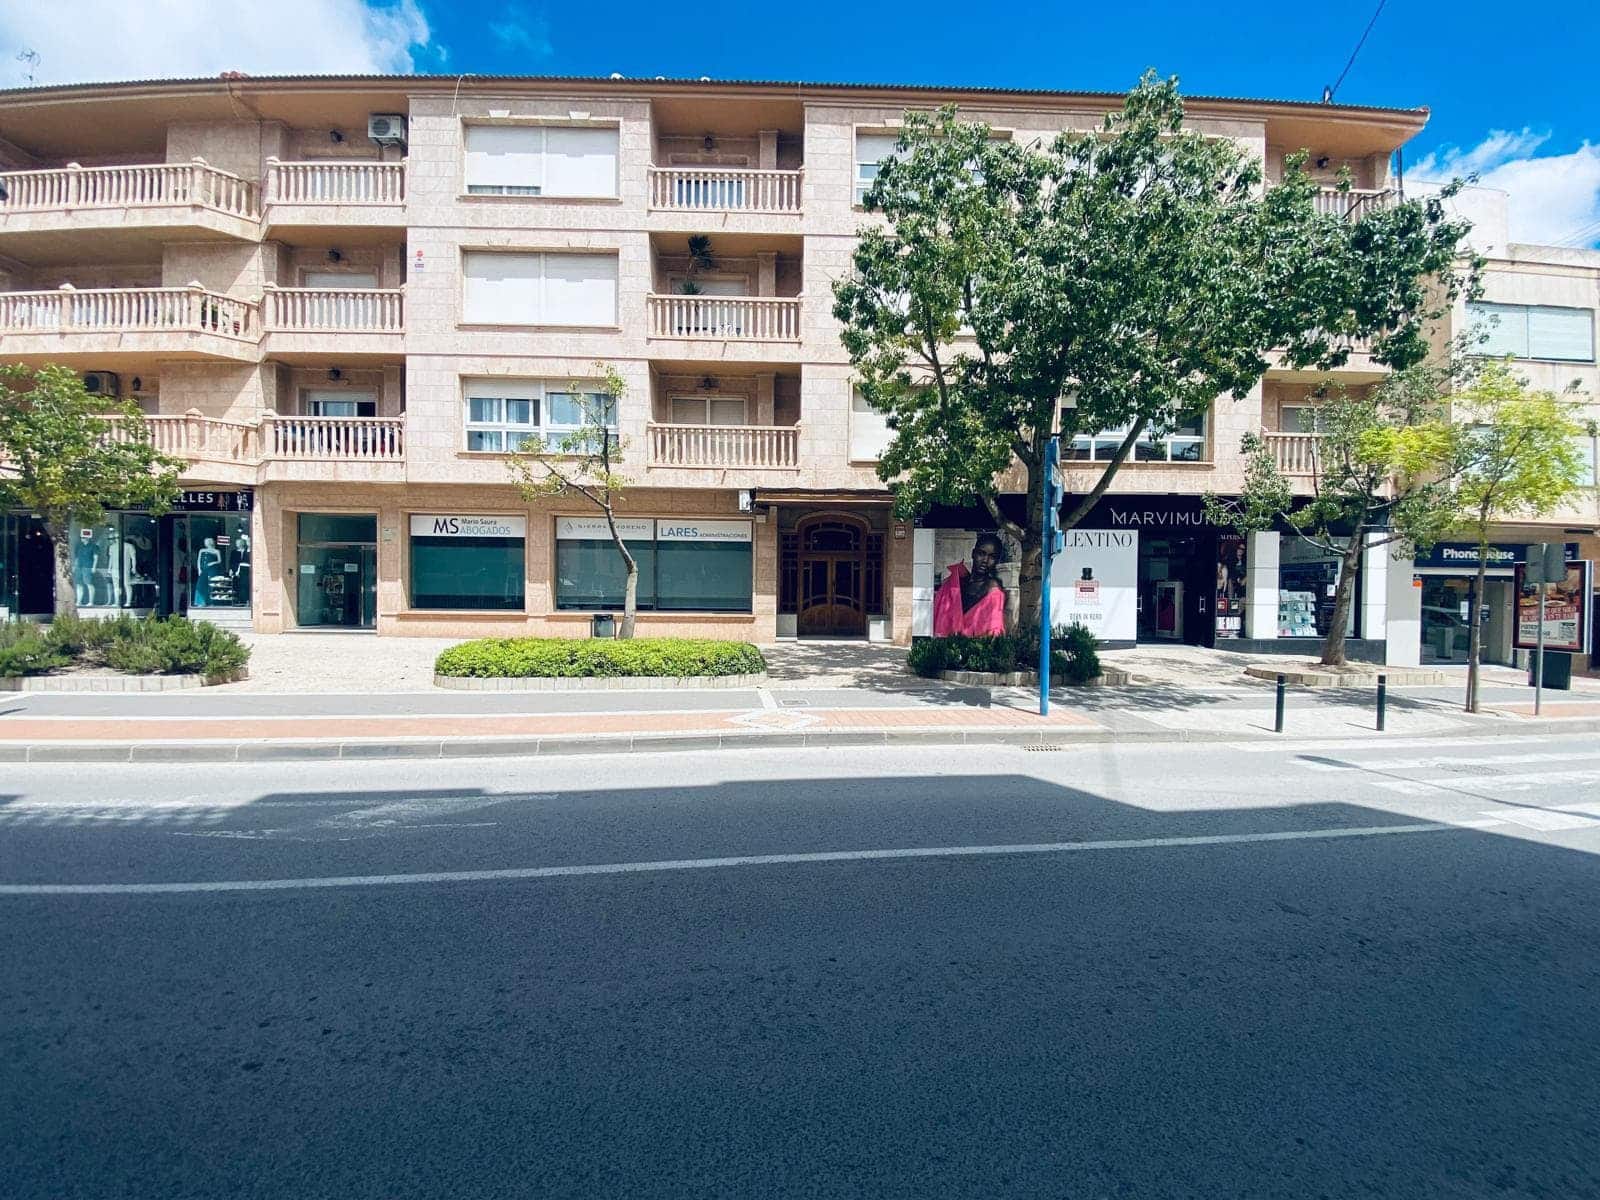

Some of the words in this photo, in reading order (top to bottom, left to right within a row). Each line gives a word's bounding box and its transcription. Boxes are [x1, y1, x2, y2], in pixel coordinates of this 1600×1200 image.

[172, 493, 214, 503] LLES
[433, 517, 459, 534] MS
[459, 526, 511, 535] ABOGADOS
[660, 527, 698, 537] LARES
[1064, 532, 1132, 547] LENTINO
[1443, 548, 1478, 560] Phone
[1484, 550, 1515, 560] ouse
